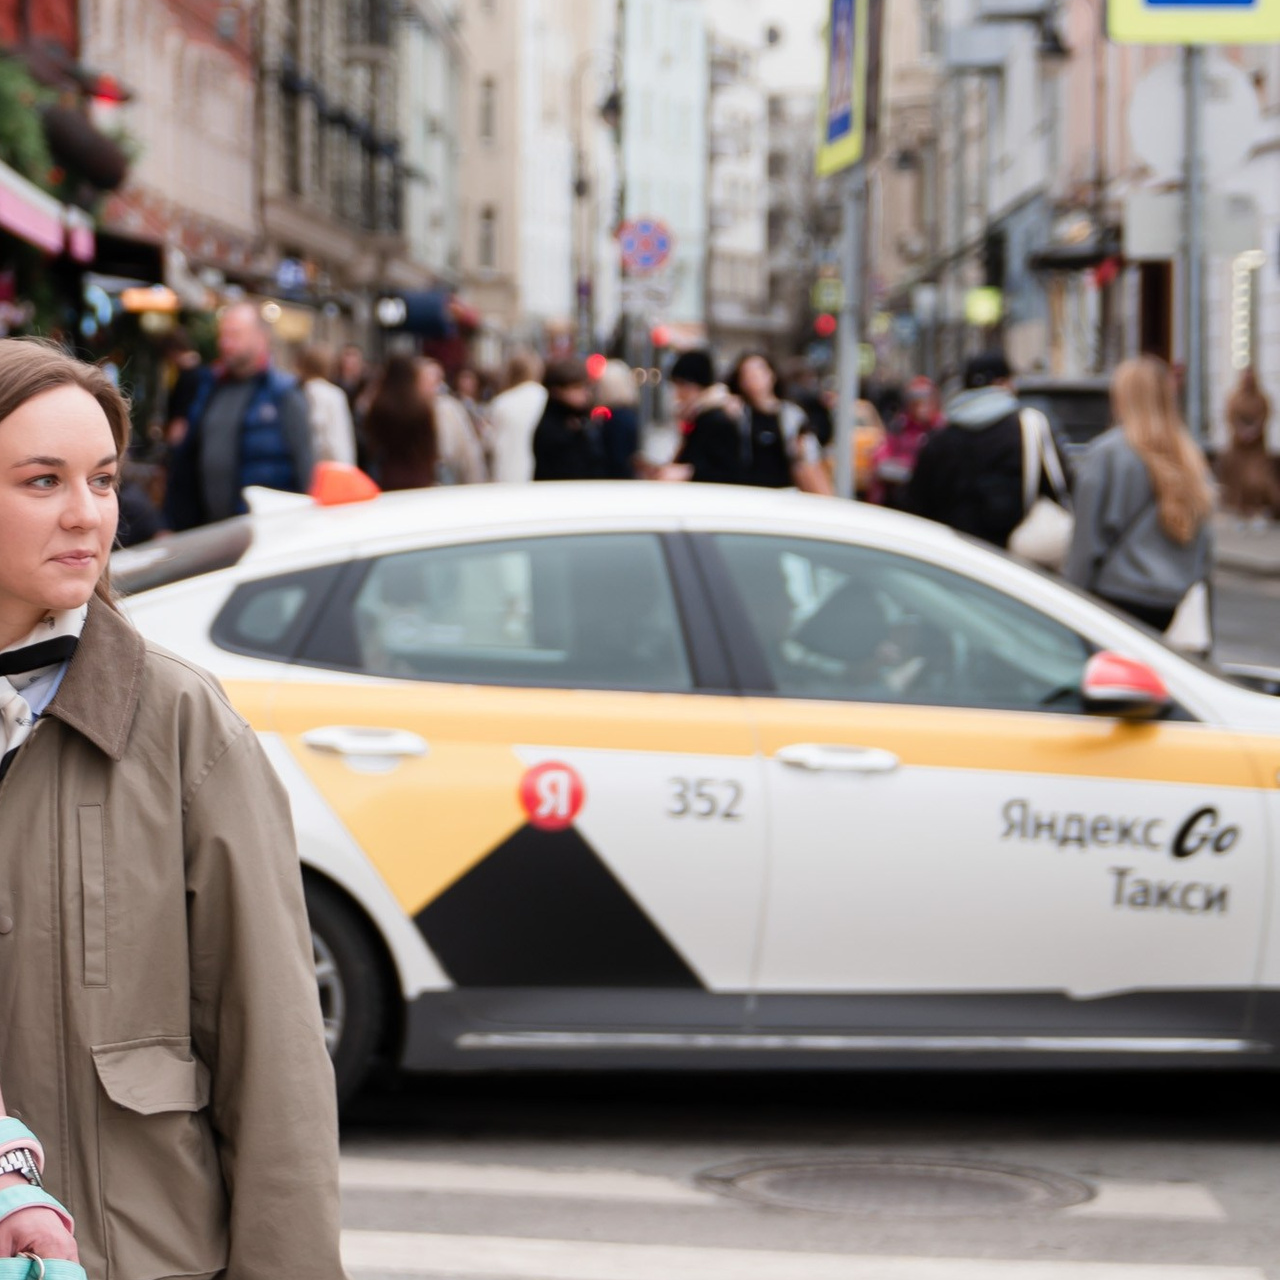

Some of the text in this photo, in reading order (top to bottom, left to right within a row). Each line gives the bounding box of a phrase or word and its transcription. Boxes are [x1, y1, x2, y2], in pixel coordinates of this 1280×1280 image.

[536, 769, 572, 820] Я
[667, 776, 745, 820] 352
[1001, 798, 1240, 859] Яндекс Go
[1108, 866, 1229, 915] Такси
